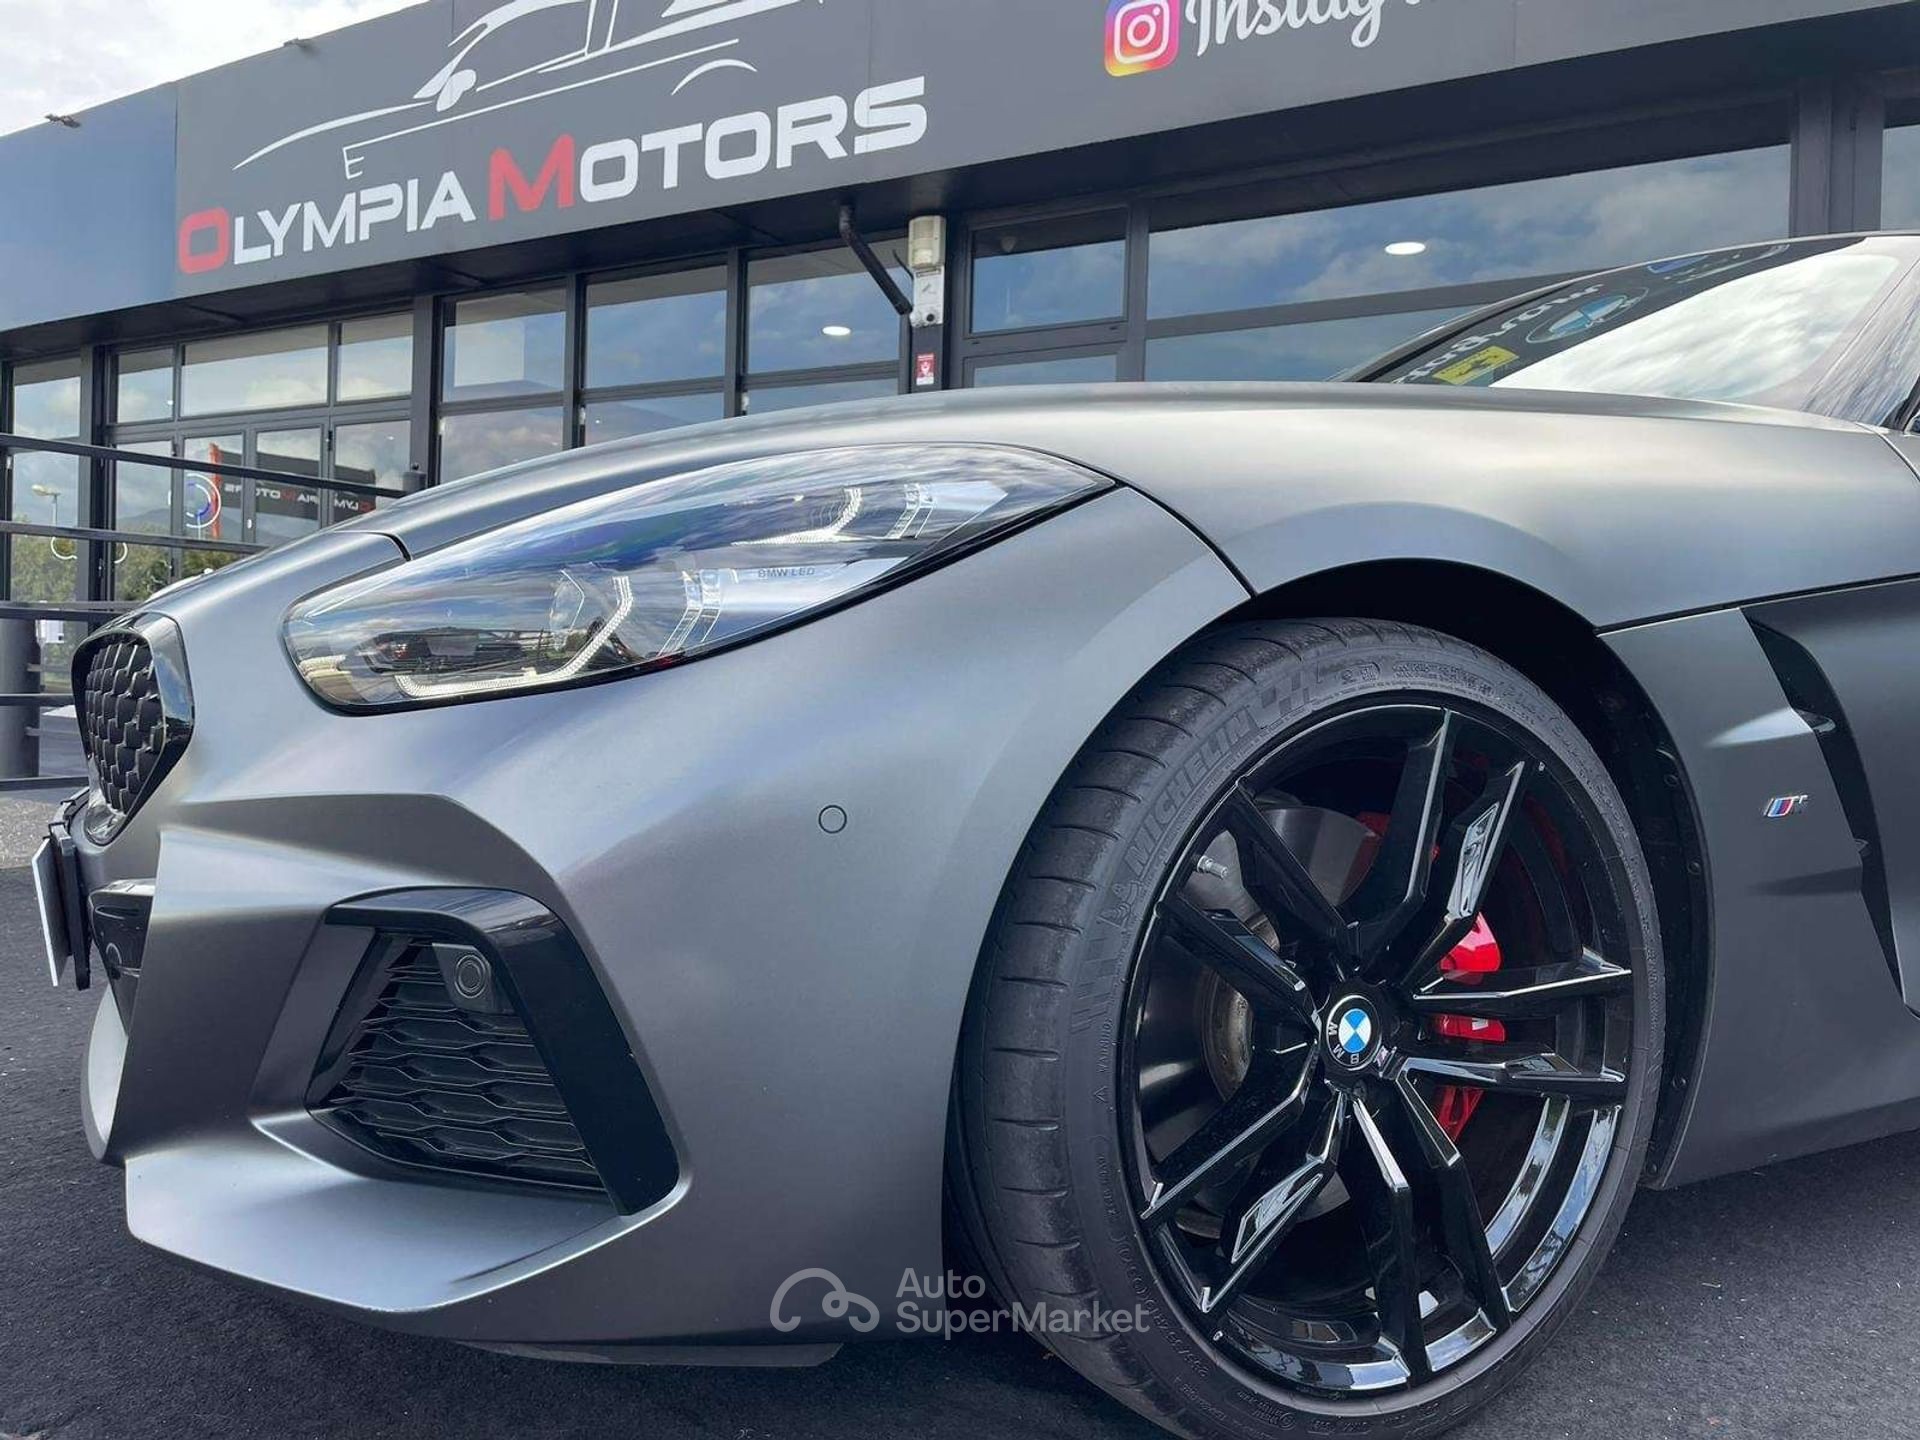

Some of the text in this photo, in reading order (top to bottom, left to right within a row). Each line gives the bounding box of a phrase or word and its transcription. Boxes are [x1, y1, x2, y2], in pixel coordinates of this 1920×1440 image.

[178, 76, 928, 275] OLYMPIA MOTORS
[757, 567, 816, 579] BMW LED
